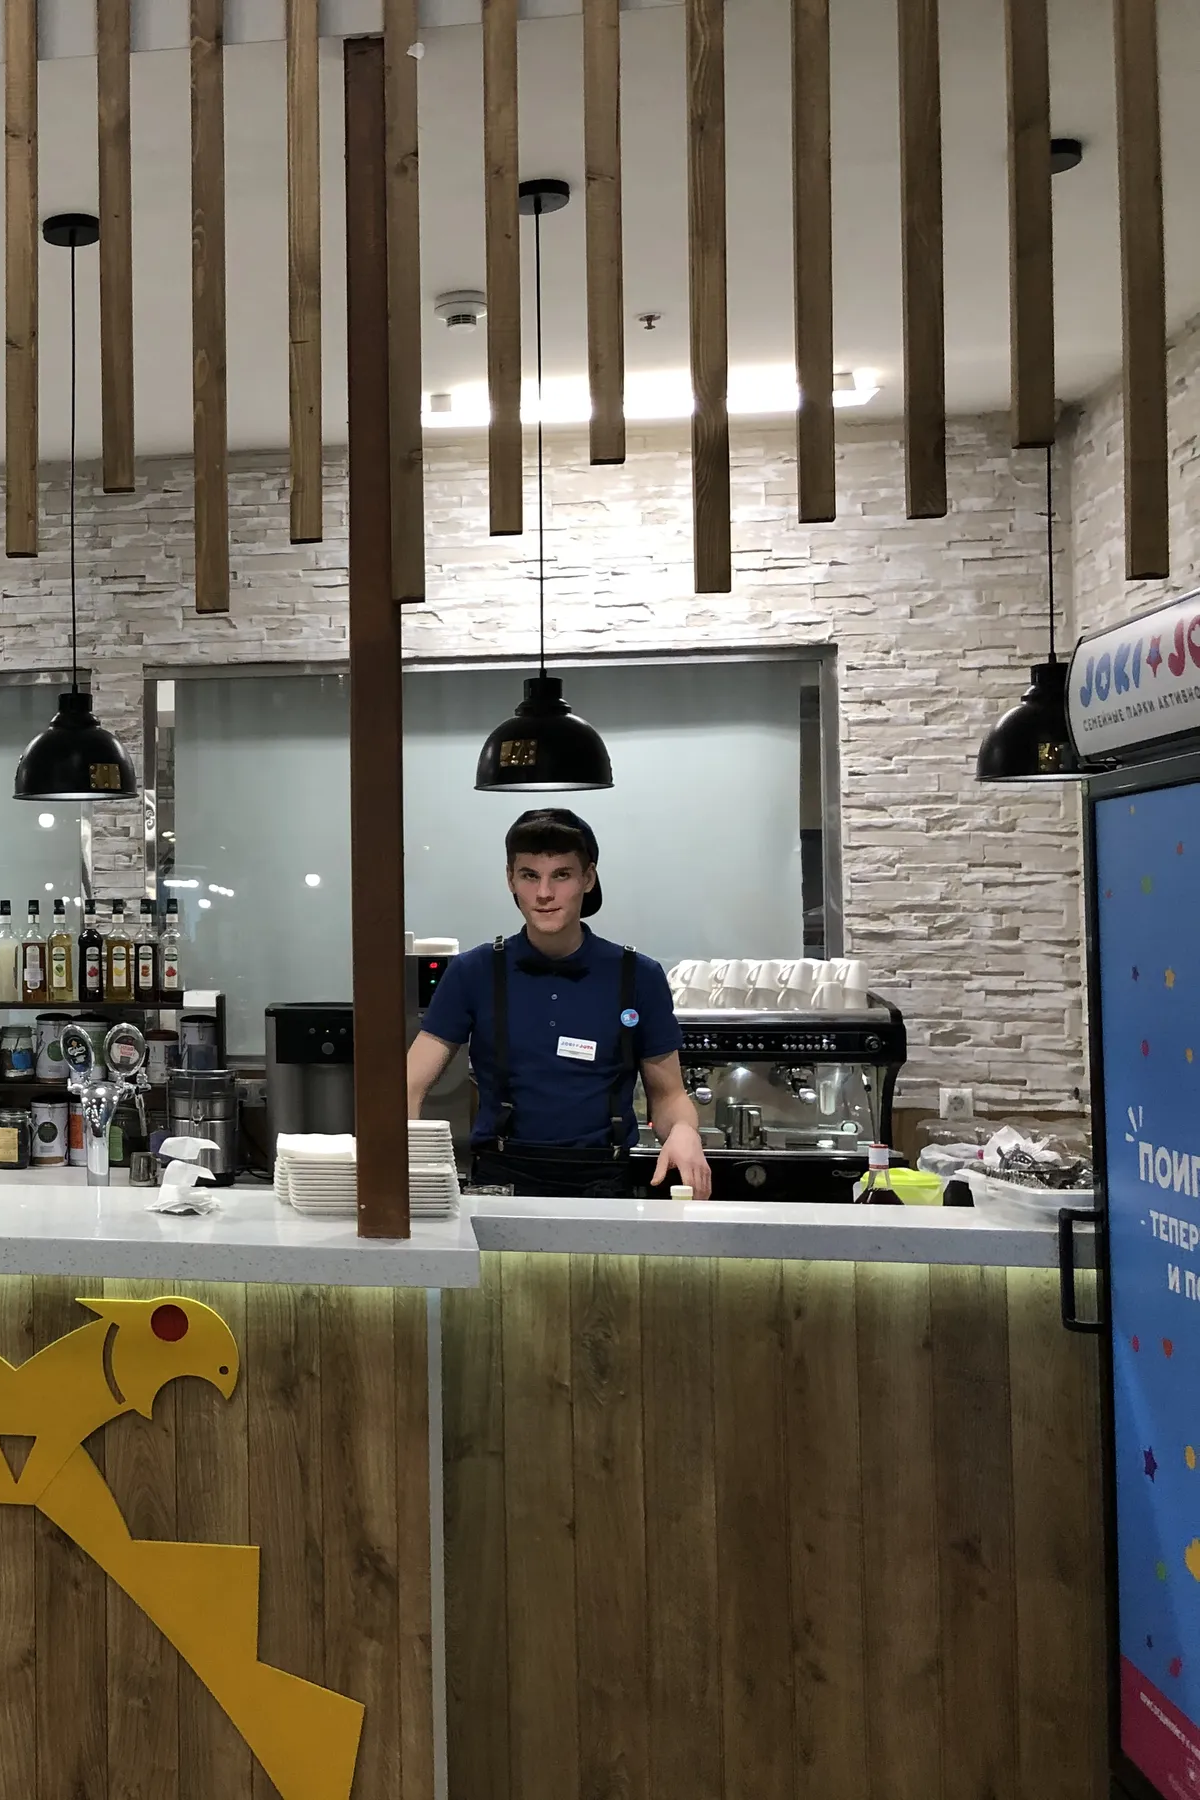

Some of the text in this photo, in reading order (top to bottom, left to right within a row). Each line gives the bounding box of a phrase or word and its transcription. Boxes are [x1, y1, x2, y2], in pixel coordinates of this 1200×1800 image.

[1079, 638, 1143, 708] JOKI
[1083, 708, 1125, 731] СЕМЕЙНЫЕ
[1126, 699, 1155, 719] ПАРКИ
[1167, 1263, 1181, 1294] И
